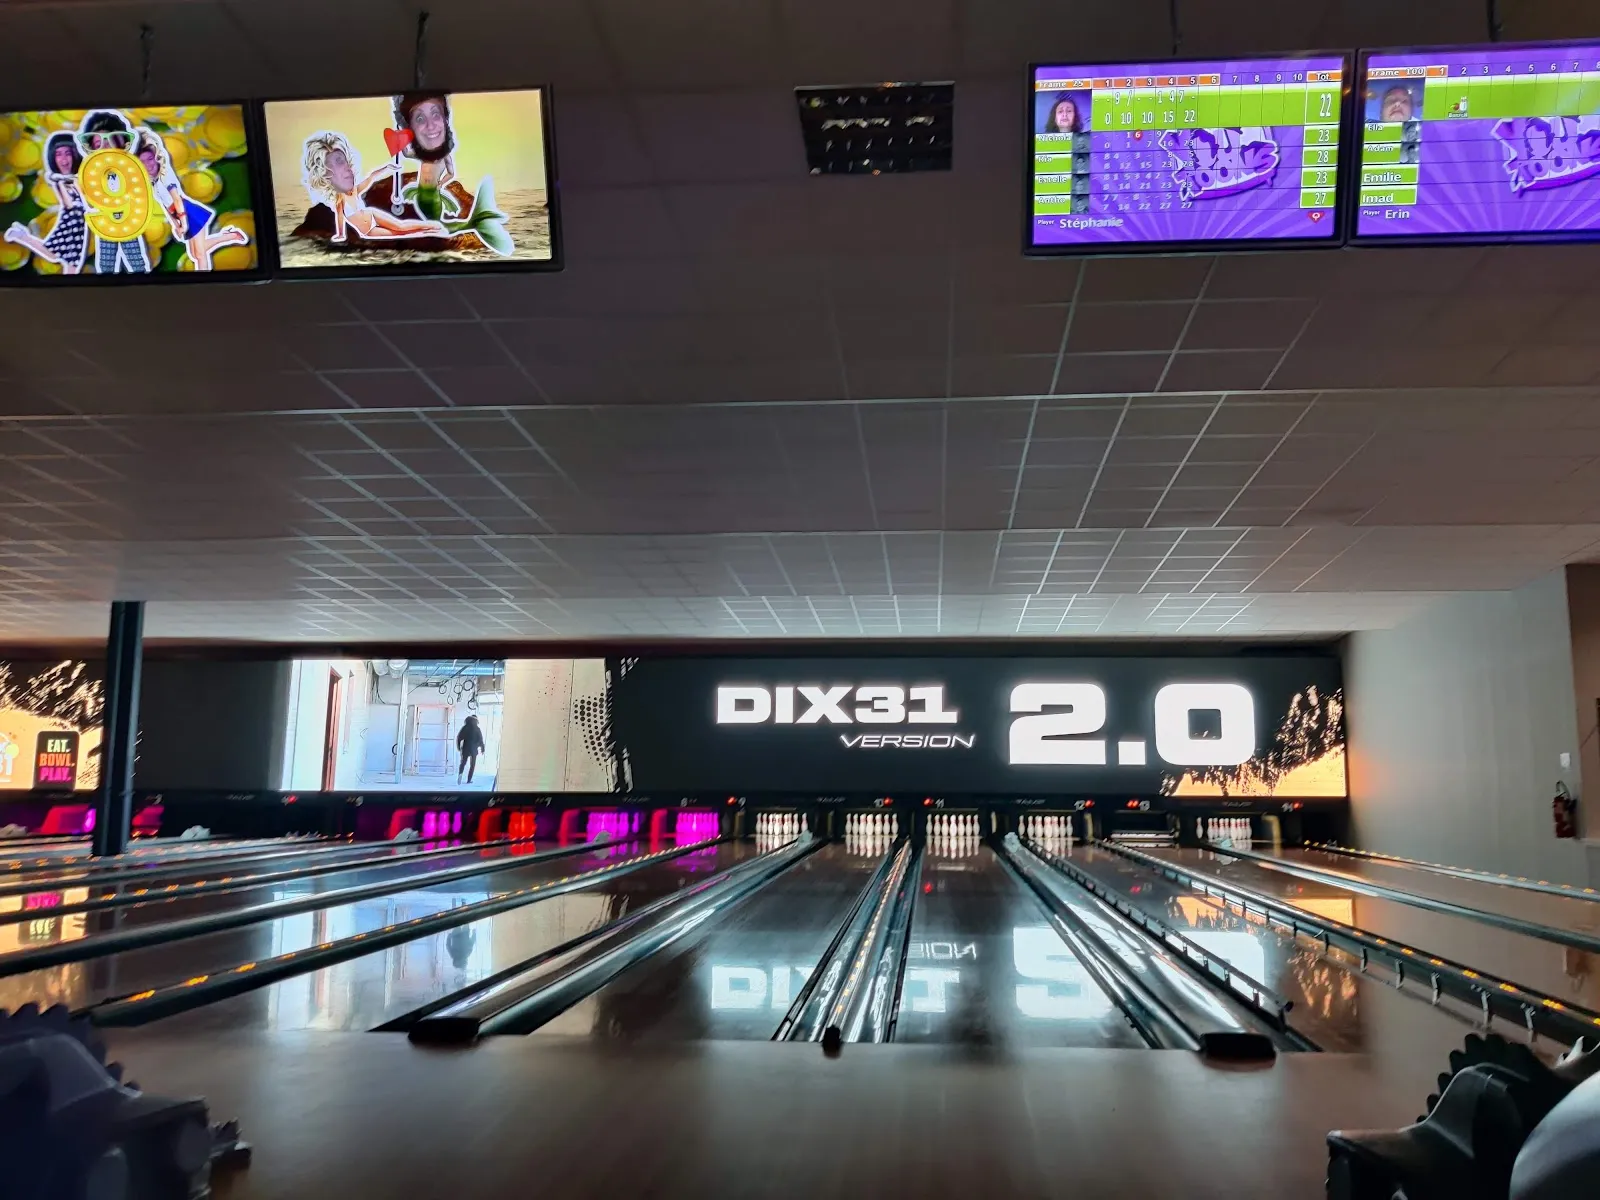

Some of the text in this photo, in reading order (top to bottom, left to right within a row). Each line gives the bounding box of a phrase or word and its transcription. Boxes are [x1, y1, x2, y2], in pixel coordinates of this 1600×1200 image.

[1293, 73, 1303, 81] 10
[1121, 112, 1132, 124] 10
[1142, 112, 1153, 124] 10
[1163, 111, 1174, 123] 15
[1184, 110, 1195, 122] 22
[1319, 93, 1332, 117] 22
[1318, 129, 1330, 142] 23
[1317, 150, 1329, 163] 28
[1316, 171, 1327, 184] 23
[1363, 172, 1402, 183] Emilie
[1314, 192, 1326, 205] 27
[1362, 193, 1393, 203] Imad
[1385, 209, 1410, 219] Erin
[1059, 217, 1123, 230] Stéphanie
[716, 686, 958, 724] DIX31
[1009, 683, 1256, 766] 2.0
[840, 734, 975, 748] VERSION
